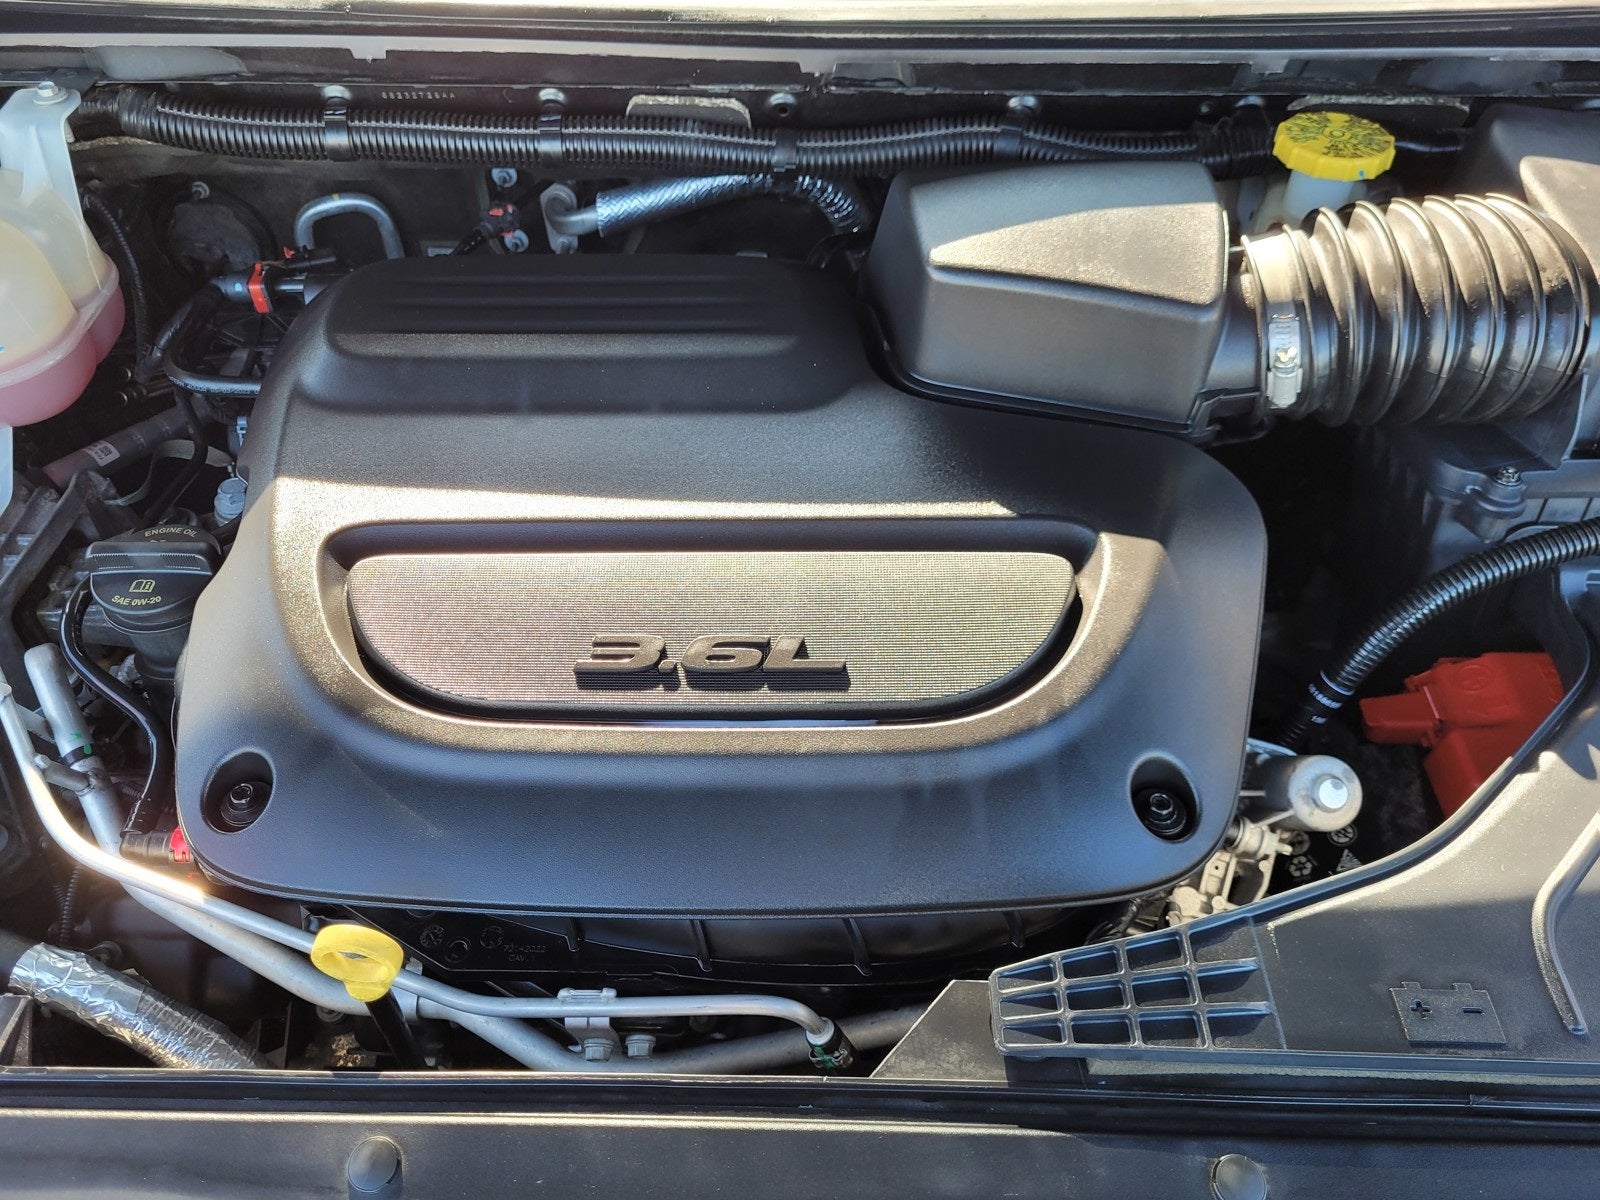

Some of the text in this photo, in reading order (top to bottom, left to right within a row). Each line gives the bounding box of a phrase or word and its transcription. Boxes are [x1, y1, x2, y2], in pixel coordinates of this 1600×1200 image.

[144, 527, 199, 538] ENGINE OIL
[112, 595, 162, 606] SAE 0W-20
[573, 634, 848, 675] 3.6L
